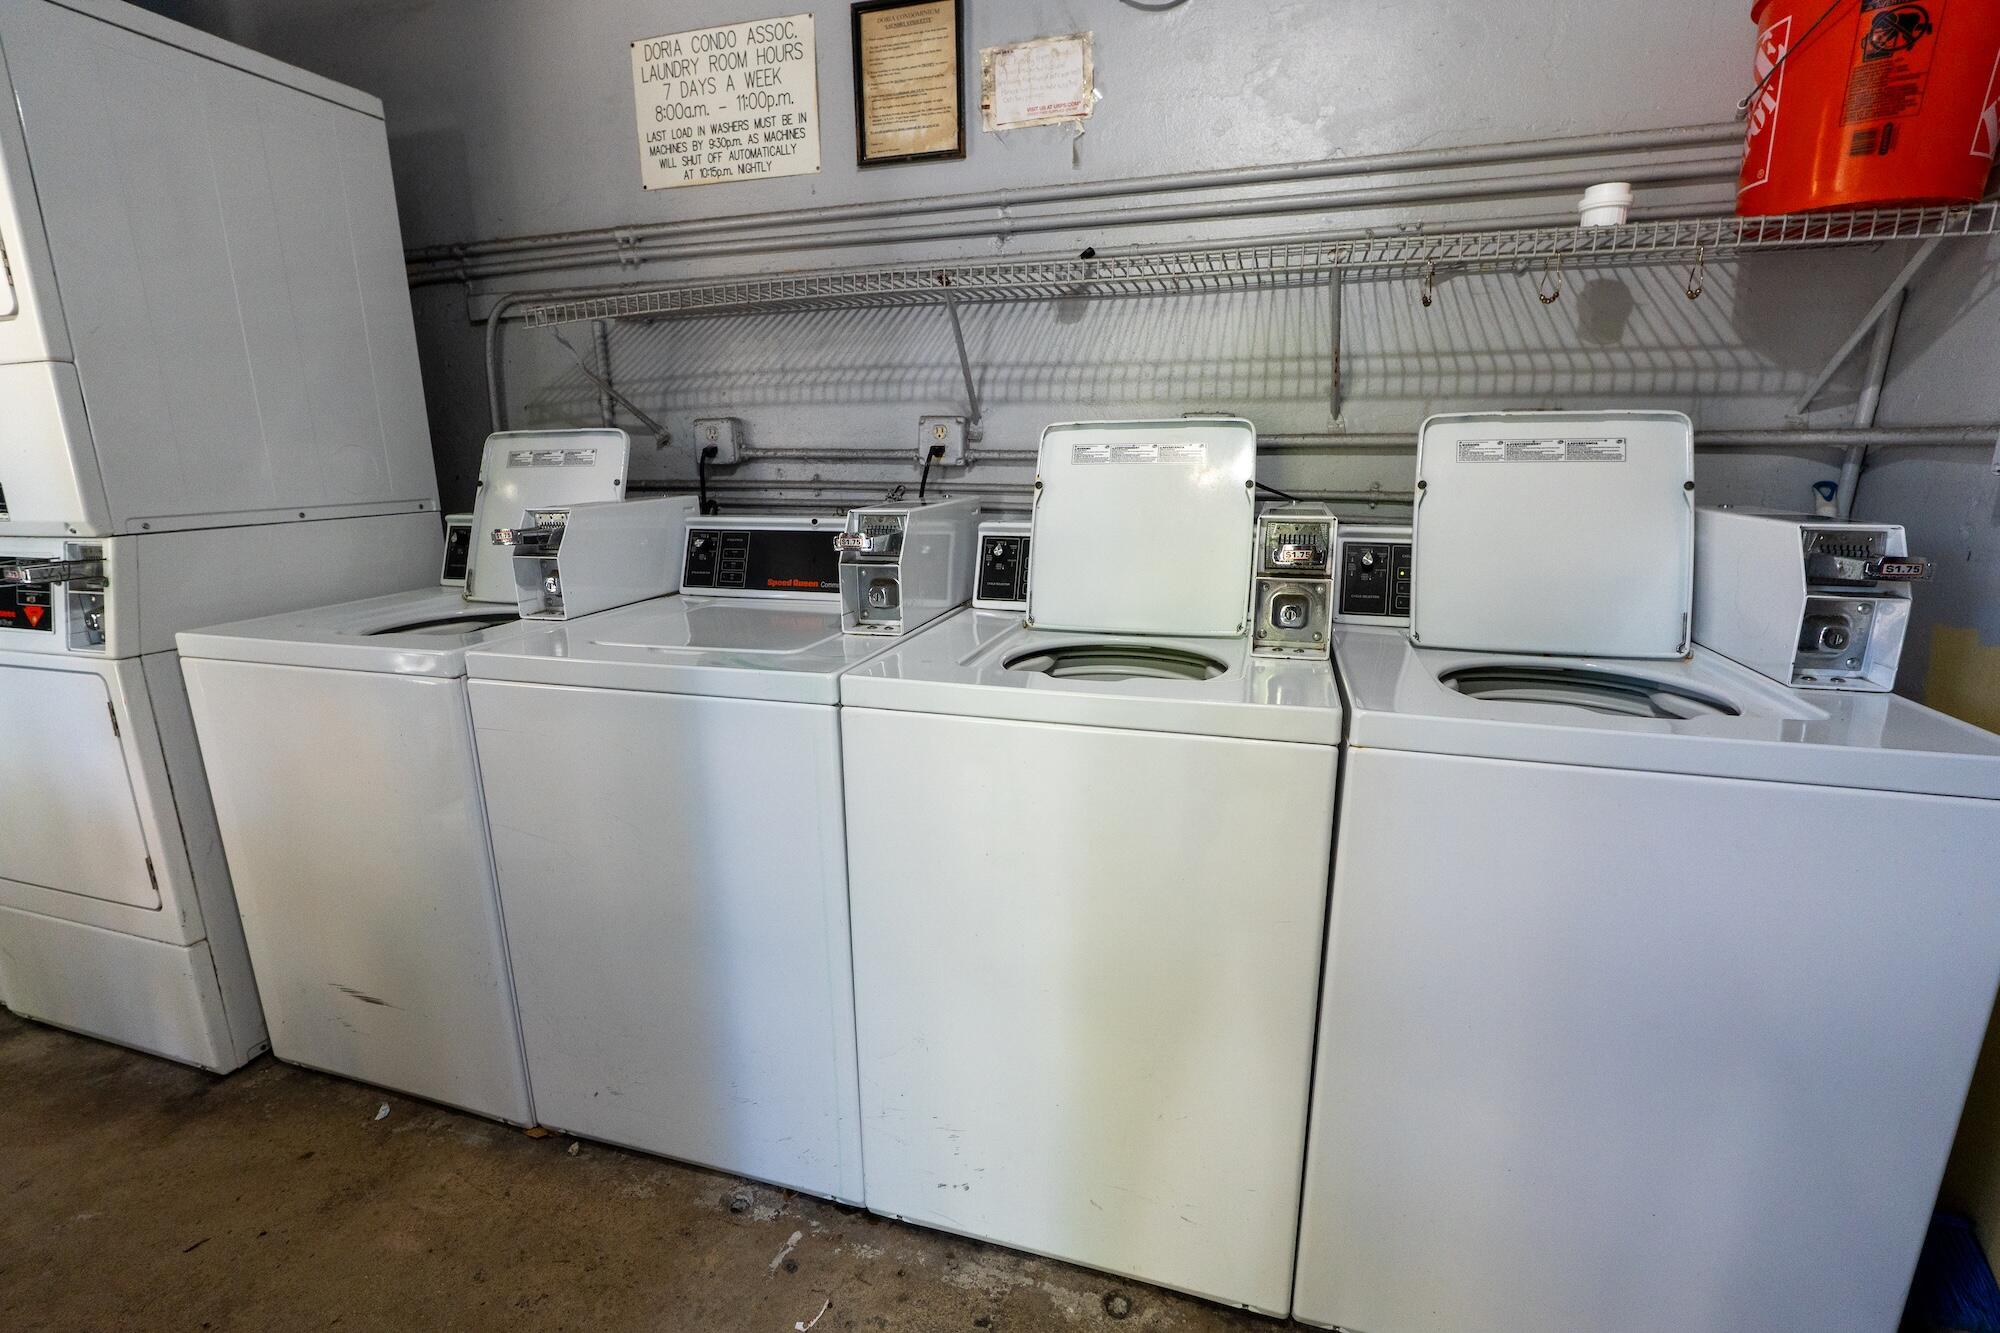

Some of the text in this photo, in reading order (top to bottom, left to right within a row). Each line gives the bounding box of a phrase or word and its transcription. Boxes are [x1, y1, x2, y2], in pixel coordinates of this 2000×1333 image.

[644, 21, 798, 62] DORIA CONDO ASSOC.
[641, 42, 804, 83] LAUNDRY ROOM HOURS
[663, 67, 782, 100] 7 DAYS A WEEK
[655, 102, 709, 123] 8:00a.m.
[736, 90, 794, 113] 11:00p.m.
[646, 111, 807, 143] LAST LOAD IN WASHERS MUST BE IN
[649, 141, 688, 157] MACHINES
[692, 140, 703, 152] BY
[748, 132, 760, 144] AS
[763, 127, 806, 143] MACHINES
[659, 143, 797, 169] WILL SHUT OFF AUTOMATICALLY
[683, 168, 694, 181] AT
[737, 160, 772, 175] NIGHTLY
[1285, 551, 1311, 559] $1.75
[1886, 565, 1920, 573] $1.75
[767, 578, 792, 587] Speed
[793, 579, 819, 588] Queen
